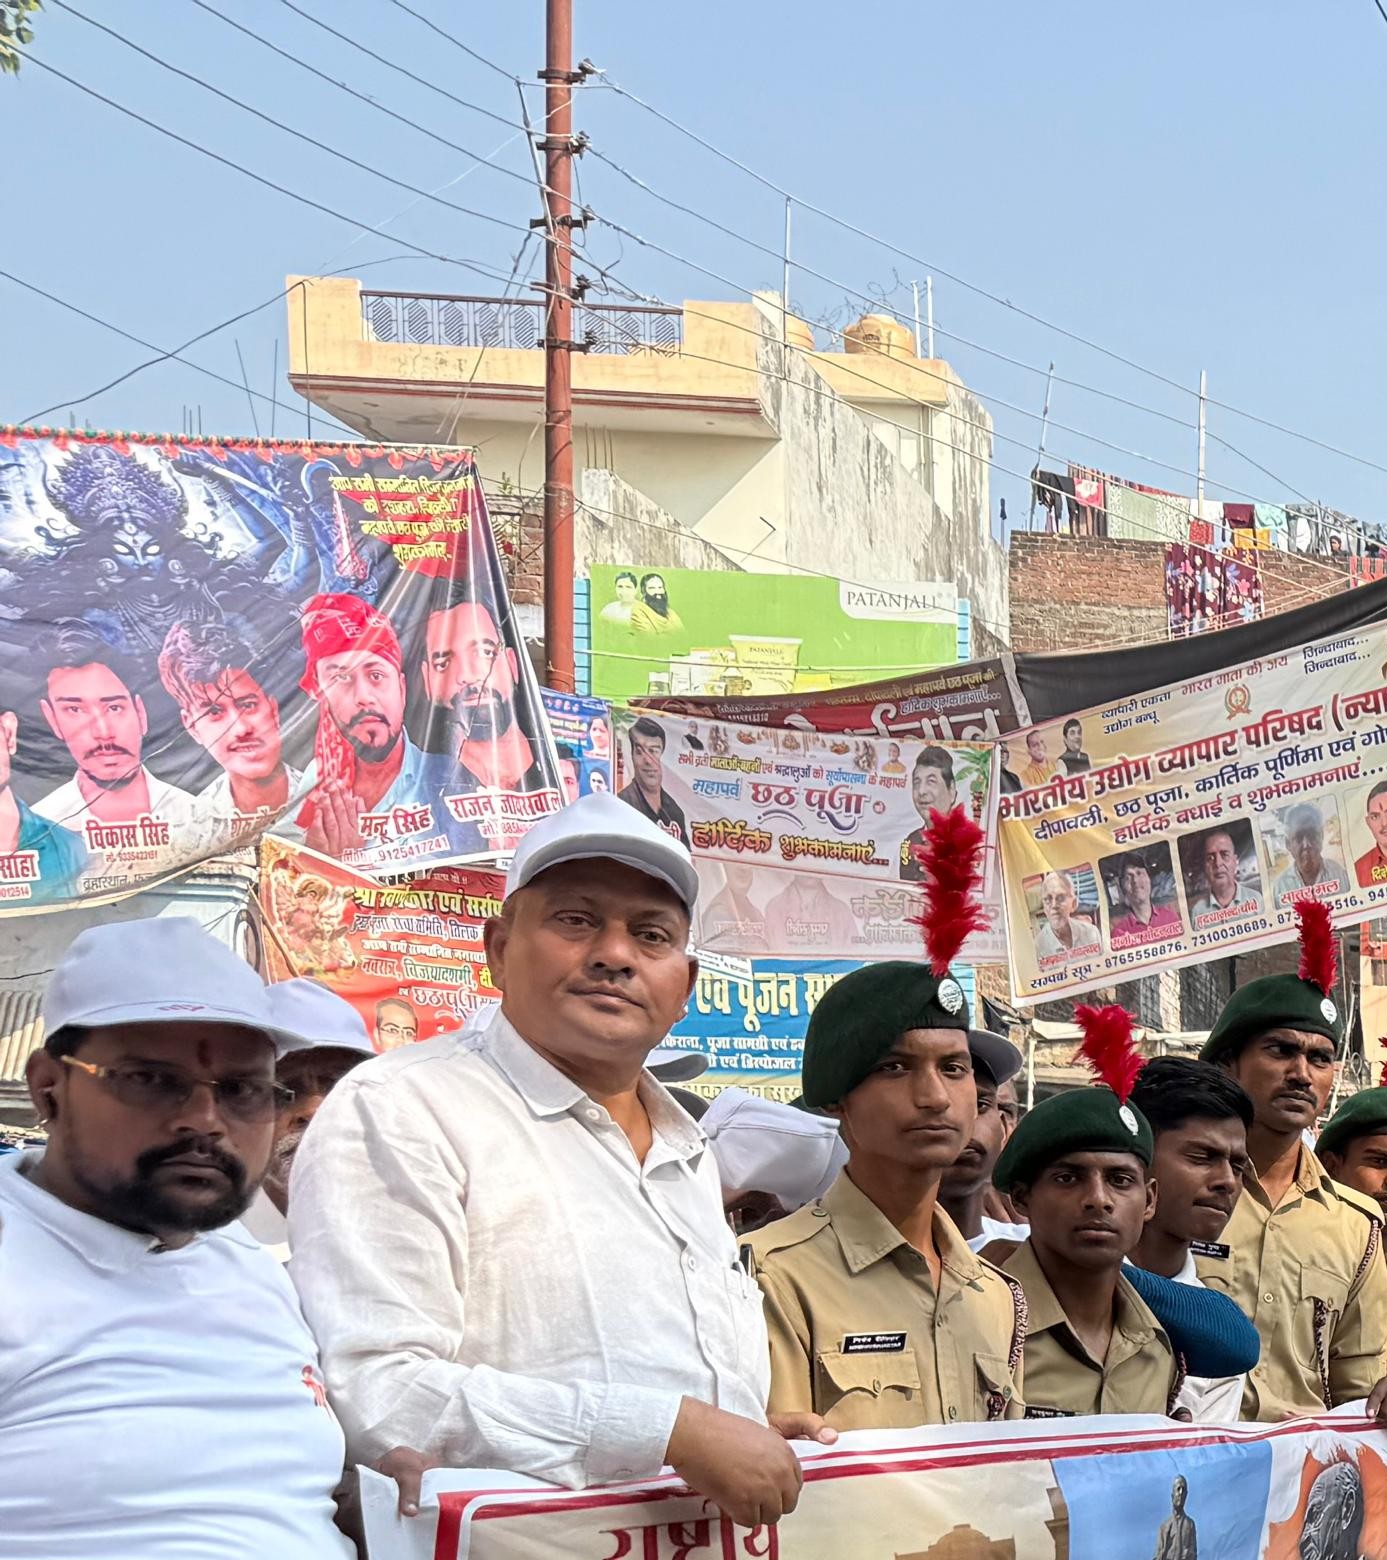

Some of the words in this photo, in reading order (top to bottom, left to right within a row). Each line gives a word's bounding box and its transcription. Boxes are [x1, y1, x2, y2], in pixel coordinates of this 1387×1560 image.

[846, 590, 938, 611] PATANJALI
[812, 764, 824, 779] को
[879, 771, 908, 790] महापर्व
[999, 771, 1087, 821] भारतीय
[1093, 752, 1152, 799] उद्योग
[1156, 729, 1239, 775] व्यापार
[1241, 703, 1325, 750] परिषद
[1034, 802, 1108, 842] दीपावली,
[1112, 800, 1143, 818] छठ
[1144, 784, 1190, 816] पूजा,
[1194, 760, 1260, 794] कार्तिक
[1264, 742, 1325, 782] पूर्णिमा
[1328, 730, 1357, 757] एवं
[393, 804, 432, 837] सिंह
[449, 789, 496, 818] राजन
[692, 776, 742, 800] महापर्व
[748, 780, 799, 808] छठ
[803, 783, 872, 836] पूजा
[1112, 811, 1173, 846] हार्दिक
[1176, 792, 1225, 827] बधाई
[1227, 791, 1242, 810] व
[85, 820, 138, 851] विकास
[140, 814, 171, 847] सिंह
[690, 814, 772, 853] हार्दिक
[437, 889, 464, 914] एवं
[1030, 967, 1069, 990] सम्पर्क
[1072, 963, 1093, 984] सूत्र
[736, 972, 799, 1033] पूजन
[707, 1036, 732, 1053] पूजा
[771, 1035, 789, 1051] एवं
[720, 1053, 738, 1069] एवं
